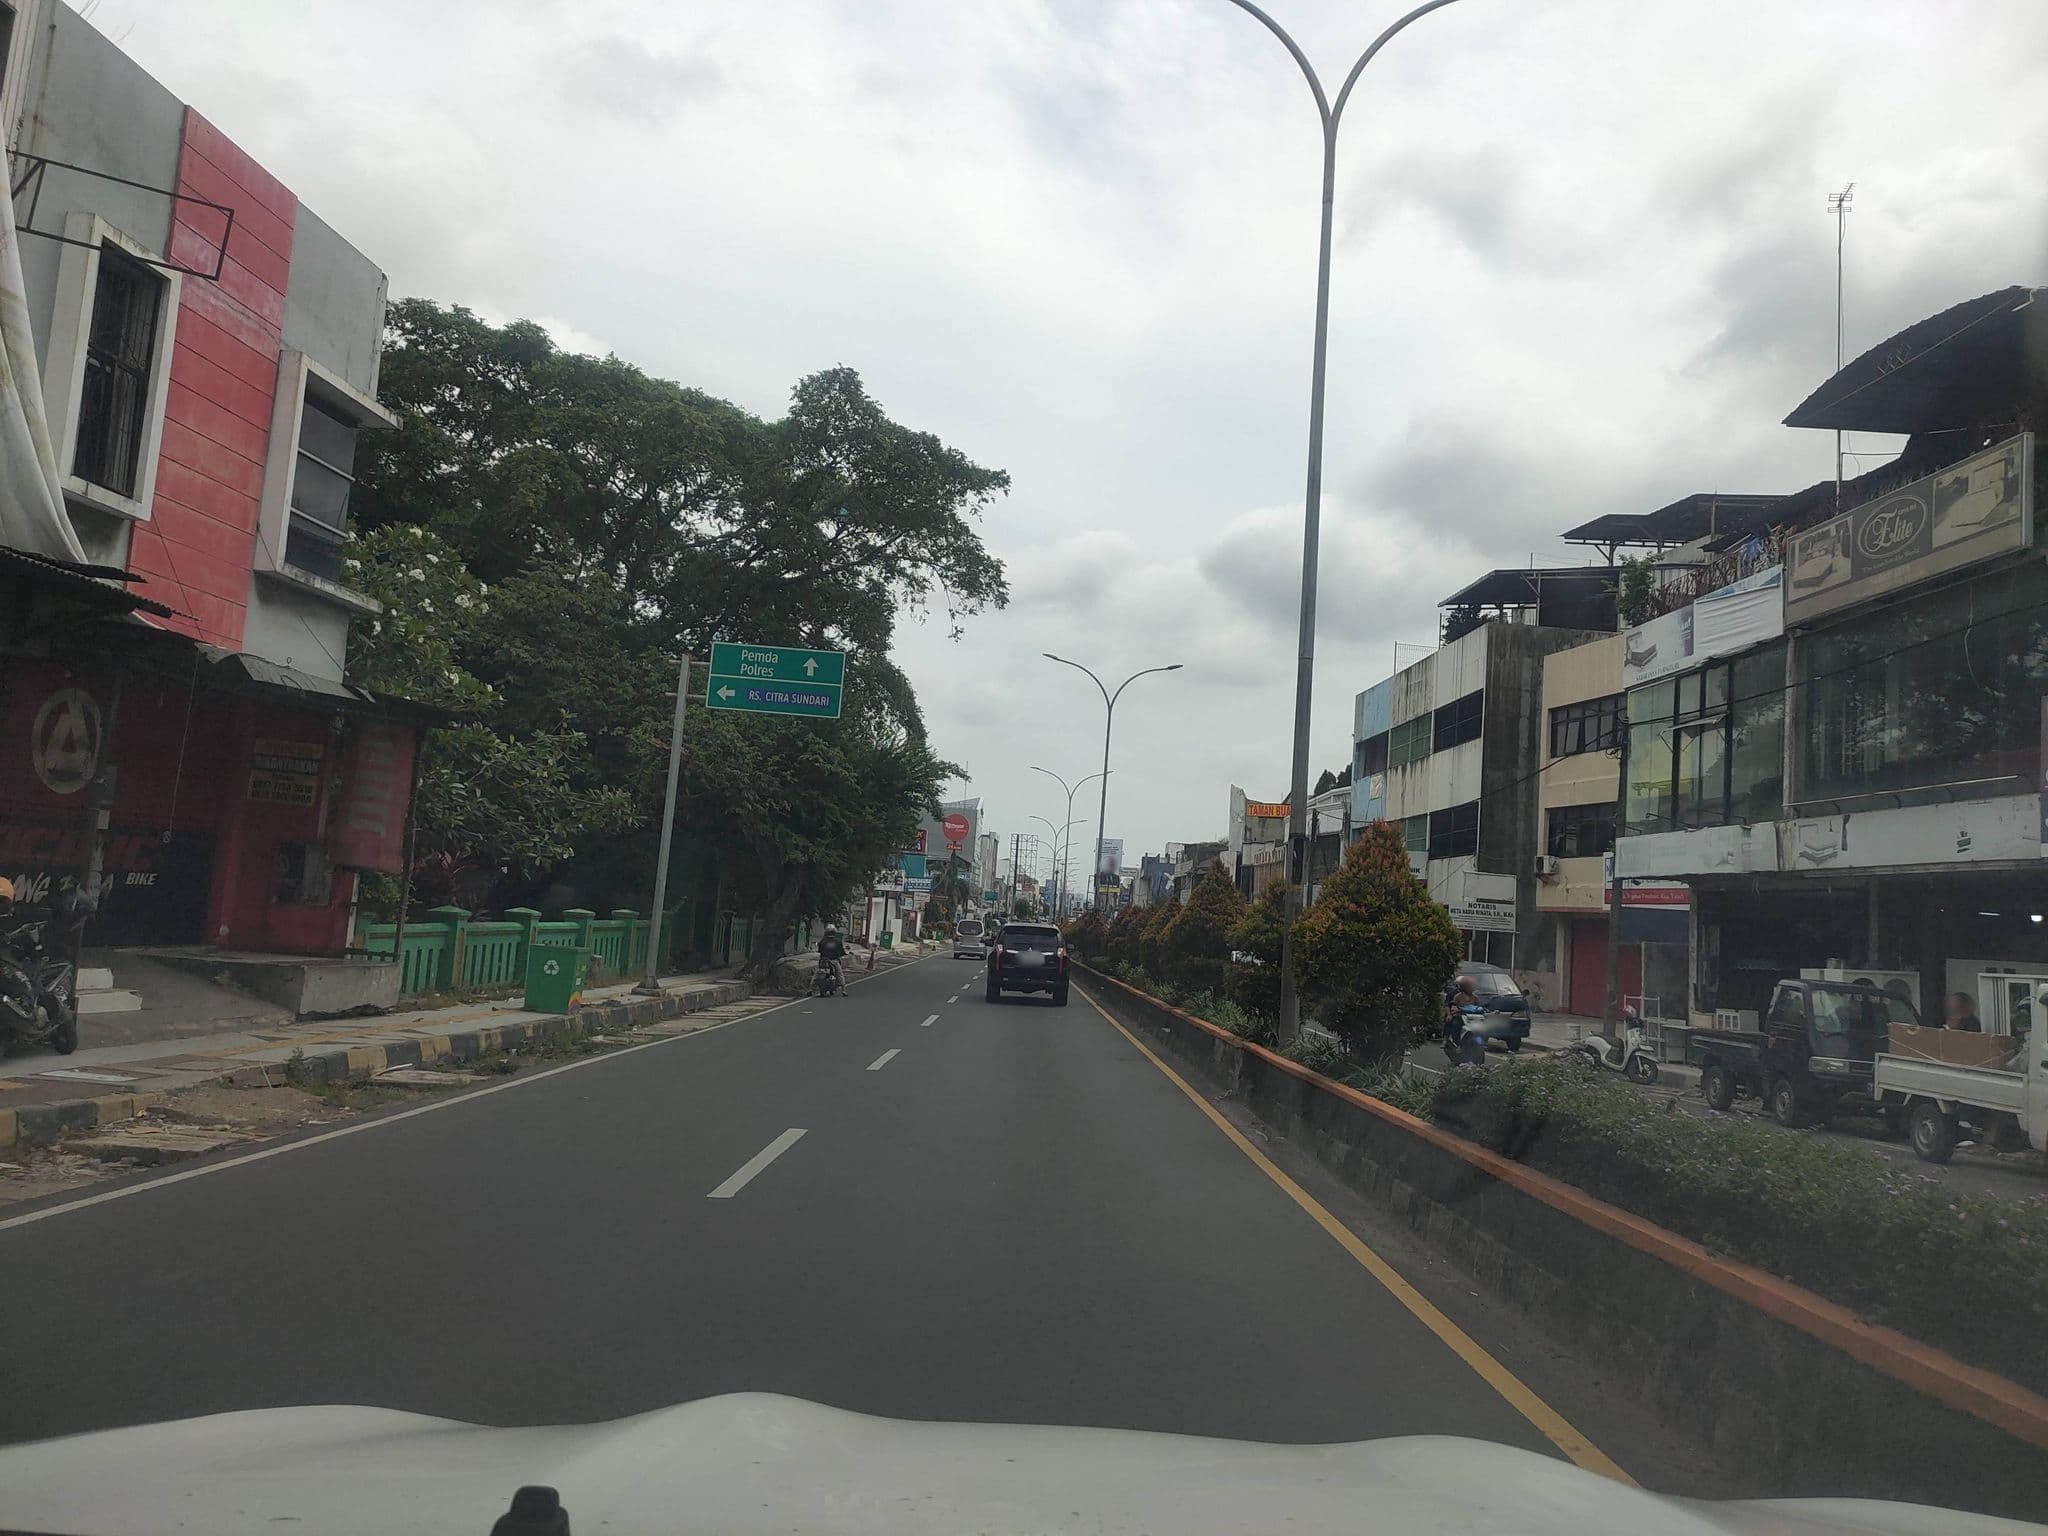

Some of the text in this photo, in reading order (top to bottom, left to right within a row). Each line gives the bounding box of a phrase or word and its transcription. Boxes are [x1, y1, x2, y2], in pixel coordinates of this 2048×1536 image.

[741, 650, 779, 664] Pemda
[740, 663, 774, 677] Polres
[749, 690, 830, 706] RS. CITRA SUNDARI
[1248, 804, 1274, 816] TAMAN
[125, 872, 158, 886] BIKE
[1467, 902, 1497, 911] NOTARIS
